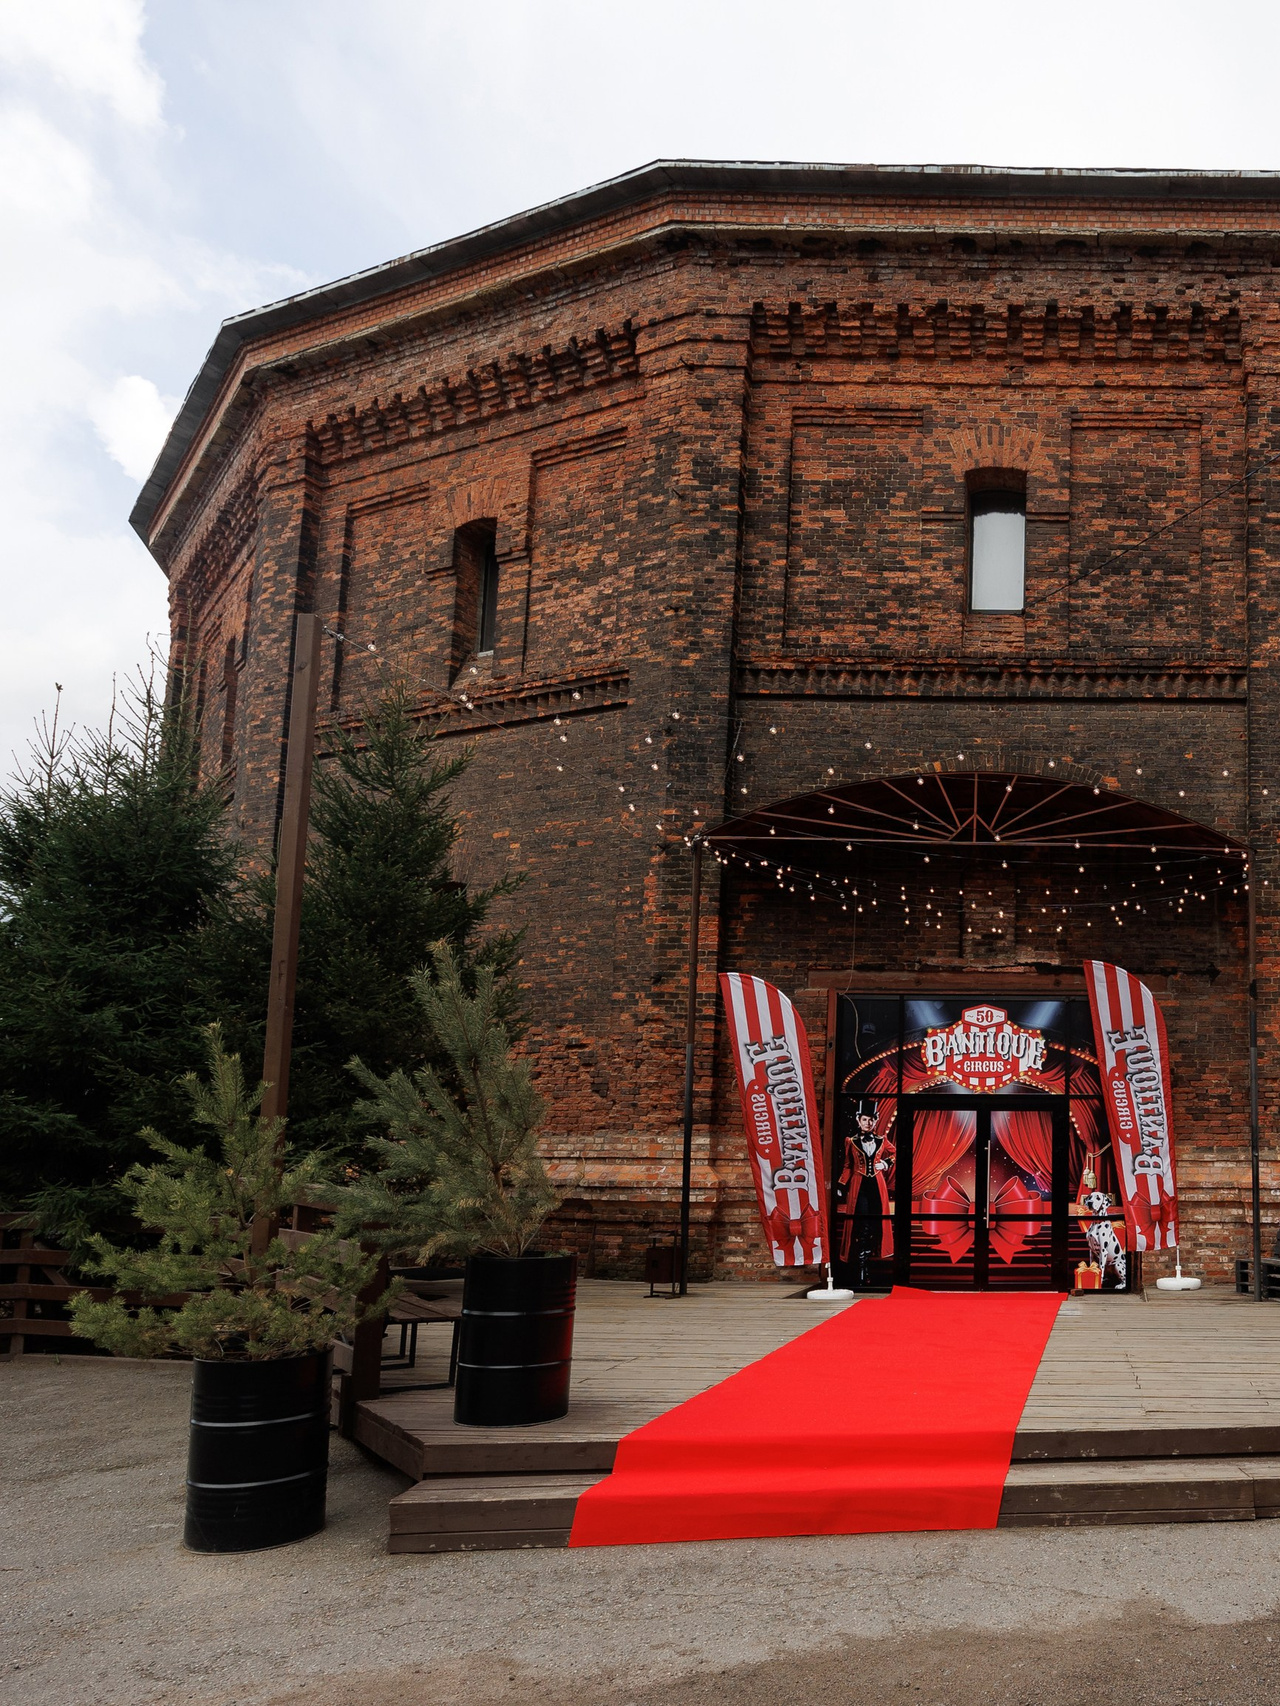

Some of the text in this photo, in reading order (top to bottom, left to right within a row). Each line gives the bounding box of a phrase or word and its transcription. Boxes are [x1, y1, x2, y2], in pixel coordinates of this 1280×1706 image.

[976, 1010, 994, 1023] 50
[924, 1031, 1046, 1070] BANTIQUE
[964, 1060, 1004, 1073] CIRCUS
